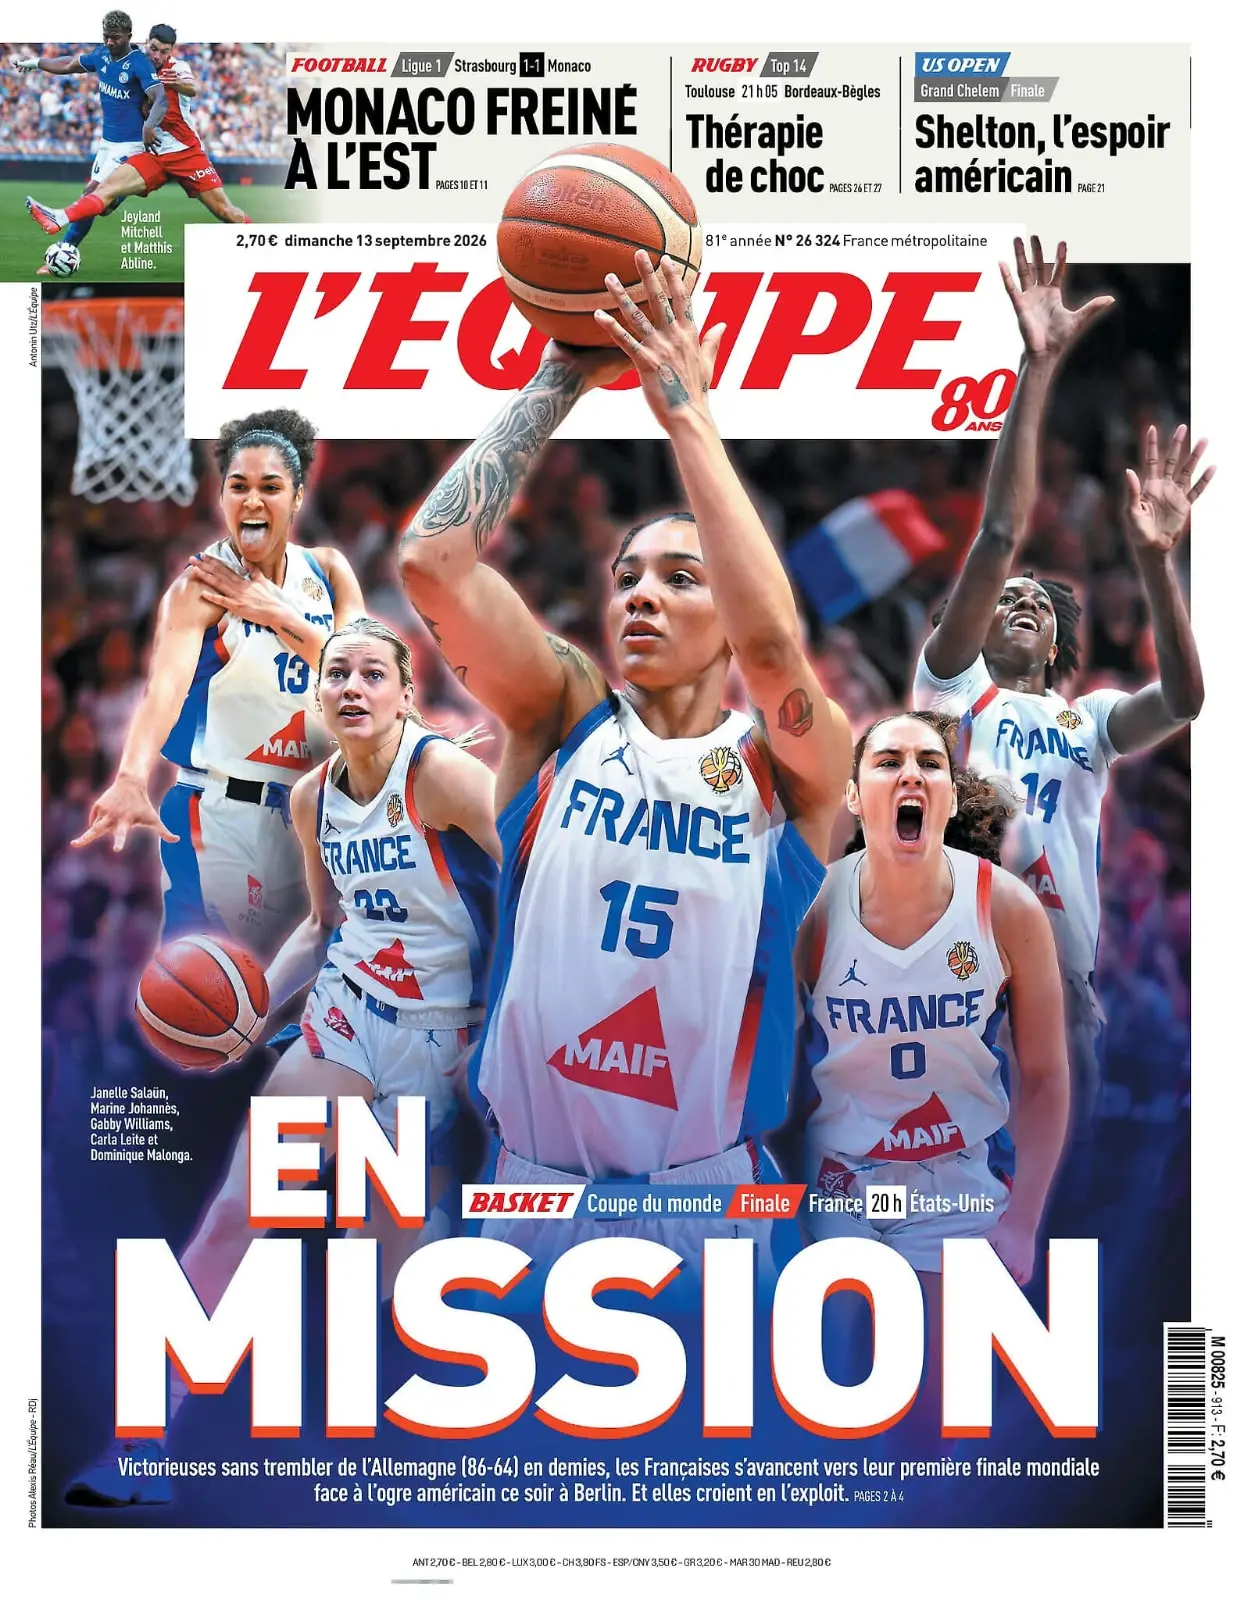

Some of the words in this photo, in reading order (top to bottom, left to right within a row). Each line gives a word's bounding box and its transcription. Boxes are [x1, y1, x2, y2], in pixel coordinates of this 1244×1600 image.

[291, 58, 387, 73] FOOTBALL
[402, 59, 432, 75] Ligue
[436, 59, 441, 73] 1
[455, 59, 516, 76] Strasbourg
[523, 59, 540, 72] 1-1
[548, 59, 591, 72] Monaco
[691, 58, 759, 72] RUGBY
[771, 59, 790, 76] Top
[794, 59, 807, 72] 14
[922, 58, 944, 72] US
[948, 58, 1000, 72] OPEN
[685, 85, 735, 98] Toulouse
[742, 85, 754, 98] 21
[757, 85, 763, 98] h
[765, 85, 778, 98] 05
[785, 84, 880, 101] Bordeaux-Bègles
[921, 84, 953, 98] Grand
[957, 84, 999, 98] Chelem
[1011, 84, 1044, 98] Finale
[286, 86, 475, 136] MONACO
[486, 84, 638, 136] FREINÉ
[686, 114, 823, 156] Thérapie
[916, 114, 1045, 156] Shelton,
[1053, 114, 1170, 156] l’espoir
[284, 138, 318, 190] À
[327, 141, 437, 190] L’EST
[436, 180, 459, 190] PAGES
[460, 180, 468, 190] 10
[470, 180, 478, 190] ET
[480, 180, 488, 190] 11
[706, 158, 743, 193] de
[750, 158, 824, 193] choc
[915, 158, 1072, 193] américain
[830, 183, 852, 193] PAGES
[854, 183, 862, 193] 26
[864, 183, 872, 193] ET
[874, 183, 882, 193] 27
[1078, 184, 1096, 193] PAGE
[1097, 184, 1105, 193] 21
[121, 210, 160, 224] Jeyland
[121, 226, 163, 238] Mitchell
[236, 234, 266, 249] 2,70
[284, 234, 353, 248] dimanche
[356, 234, 373, 248] 13
[375, 234, 451, 250] septembre
[454, 234, 487, 248] 2026
[730, 234, 772, 247] année
[775, 234, 793, 247] N°
[796, 234, 812, 247] 26
[815, 234, 840, 247] 324
[843, 234, 888, 247] France
[891, 234, 988, 249] métropolitaine
[121, 242, 132, 254] et
[134, 242, 172, 254] Matthis
[121, 258, 156, 270] Abline.
[222, 262, 981, 391] L’ÉQIPE
[28, 336, 38, 368] Antonin
[932, 368, 1018, 431] 80
[964, 422, 1004, 432] ANS
[274, 652, 310, 695] 13
[1020, 772, 1062, 824] 14
[560, 779, 750, 864] FRANCE
[322, 834, 416, 875] FRANCE
[600, 879, 678, 960] 15
[826, 988, 984, 1034] FRANCE
[564, 1033, 666, 1078] MAIF
[890, 1041, 926, 1080] 0
[90, 1086, 128, 1099] Janelle
[130, 1086, 169, 1100] Salaün,
[90, 1102, 126, 1114] Marine
[128, 1102, 180, 1116] Johannès,
[90, 1118, 122, 1132] Gabby
[124, 1118, 174, 1132] Williams,
[90, 1134, 118, 1146] Carla
[120, 1134, 146, 1146] Leite
[148, 1134, 158, 1146] et
[884, 1122, 958, 1152] MAIF
[90, 1149, 144, 1164] Dominique
[147, 1149, 193, 1164] Malonga.
[249, 1096, 427, 1228] EN
[468, 1192, 576, 1213] BASKET
[587, 1193, 638, 1216] Coupe
[642, 1193, 662, 1213] du
[666, 1193, 722, 1213] monde
[740, 1193, 790, 1213] Finale
[809, 1194, 864, 1213] France
[872, 1194, 889, 1213] 20
[893, 1194, 902, 1213] h
[910, 1188, 994, 1213] États-Unis
[116, 1237, 1101, 1439] MISSION
[1211, 1336, 1226, 1347] M
[1211, 1350, 1226, 1388] 00825
[1211, 1397, 1223, 1416] 913
[1208, 1440, 1226, 1467] 2,70
[117, 1457, 216, 1477] Victorieuses
[221, 1462, 259, 1477] sans
[264, 1457, 333, 1477] trembler
[338, 1457, 356, 1477] de
[362, 1457, 456, 1482] l’Allemagne
[461, 1455, 519, 1478] (86-64)
[524, 1462, 543, 1477] en
[548, 1457, 610, 1480] demies,
[615, 1457, 640, 1477] les
[644, 1457, 730, 1482] Françaises
[734, 1457, 819, 1477] s’avancent
[824, 1462, 858, 1477] vers
[863, 1457, 894, 1477] leur
[900, 1457, 972, 1481] première
[976, 1457, 1022, 1477] finale
[1026, 1457, 1100, 1477] mondiale
[28, 1476, 36, 1500] Alexis
[314, 1483, 348, 1502] face
[353, 1483, 362, 1502] à
[368, 1483, 412, 1507] l’ogre
[416, 1483, 496, 1502] américain
[501, 1488, 520, 1502] ce
[524, 1483, 554, 1502] soir
[559, 1483, 569, 1502] à
[574, 1483, 626, 1502] Berlin.
[632, 1483, 648, 1502] Et
[652, 1483, 692, 1502] elles
[696, 1483, 752, 1502] croient
[757, 1488, 776, 1502] en
[782, 1483, 850, 1506] l’exploit.
[854, 1490, 881, 1502] PAGES
[883, 1490, 888, 1502] 2
[890, 1486, 897, 1502] À
[898, 1490, 904, 1502] 4
[28, 1500, 36, 1528] Photos
